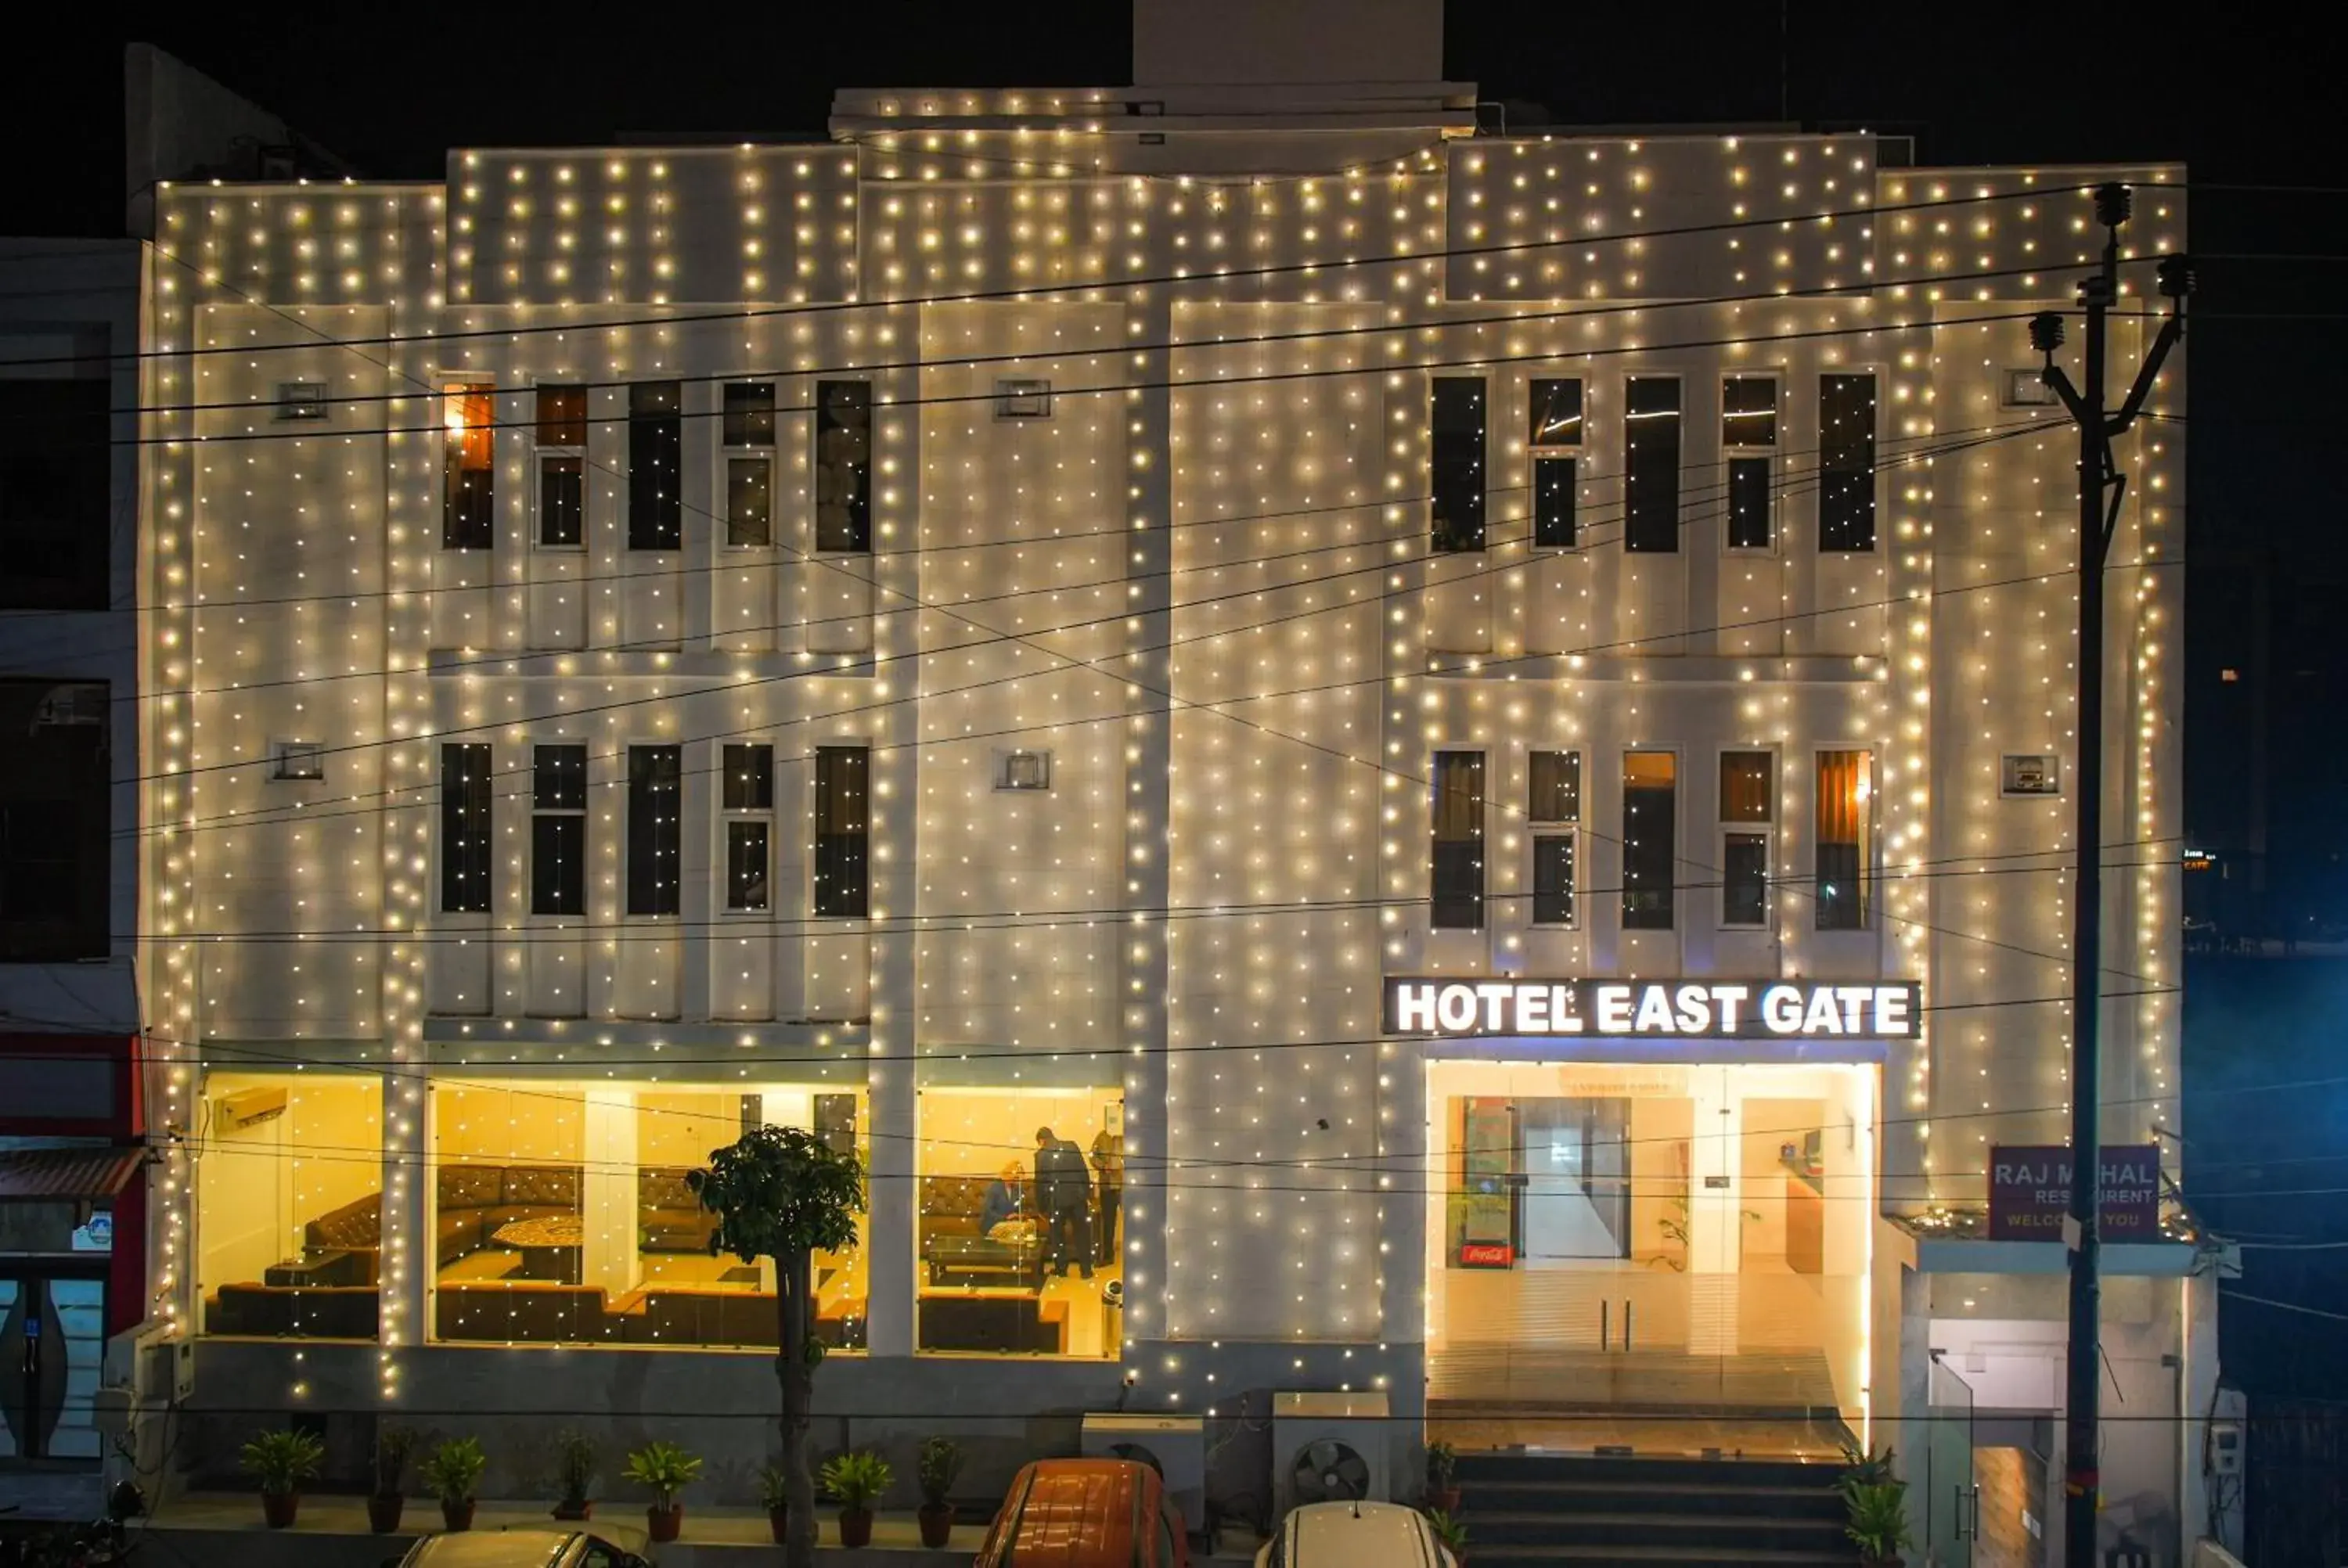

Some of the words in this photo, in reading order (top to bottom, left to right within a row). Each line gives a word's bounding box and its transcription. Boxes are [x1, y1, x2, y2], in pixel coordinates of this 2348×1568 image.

[1398, 984, 1583, 1031] HOTEL
[1597, 985, 1748, 1033] EAST
[1762, 986, 1910, 1034] GATE
[1995, 1163, 2047, 1185] RAJ
[2058, 1163, 2153, 1185] MHAL
[2105, 1214, 2139, 1226] YOU
